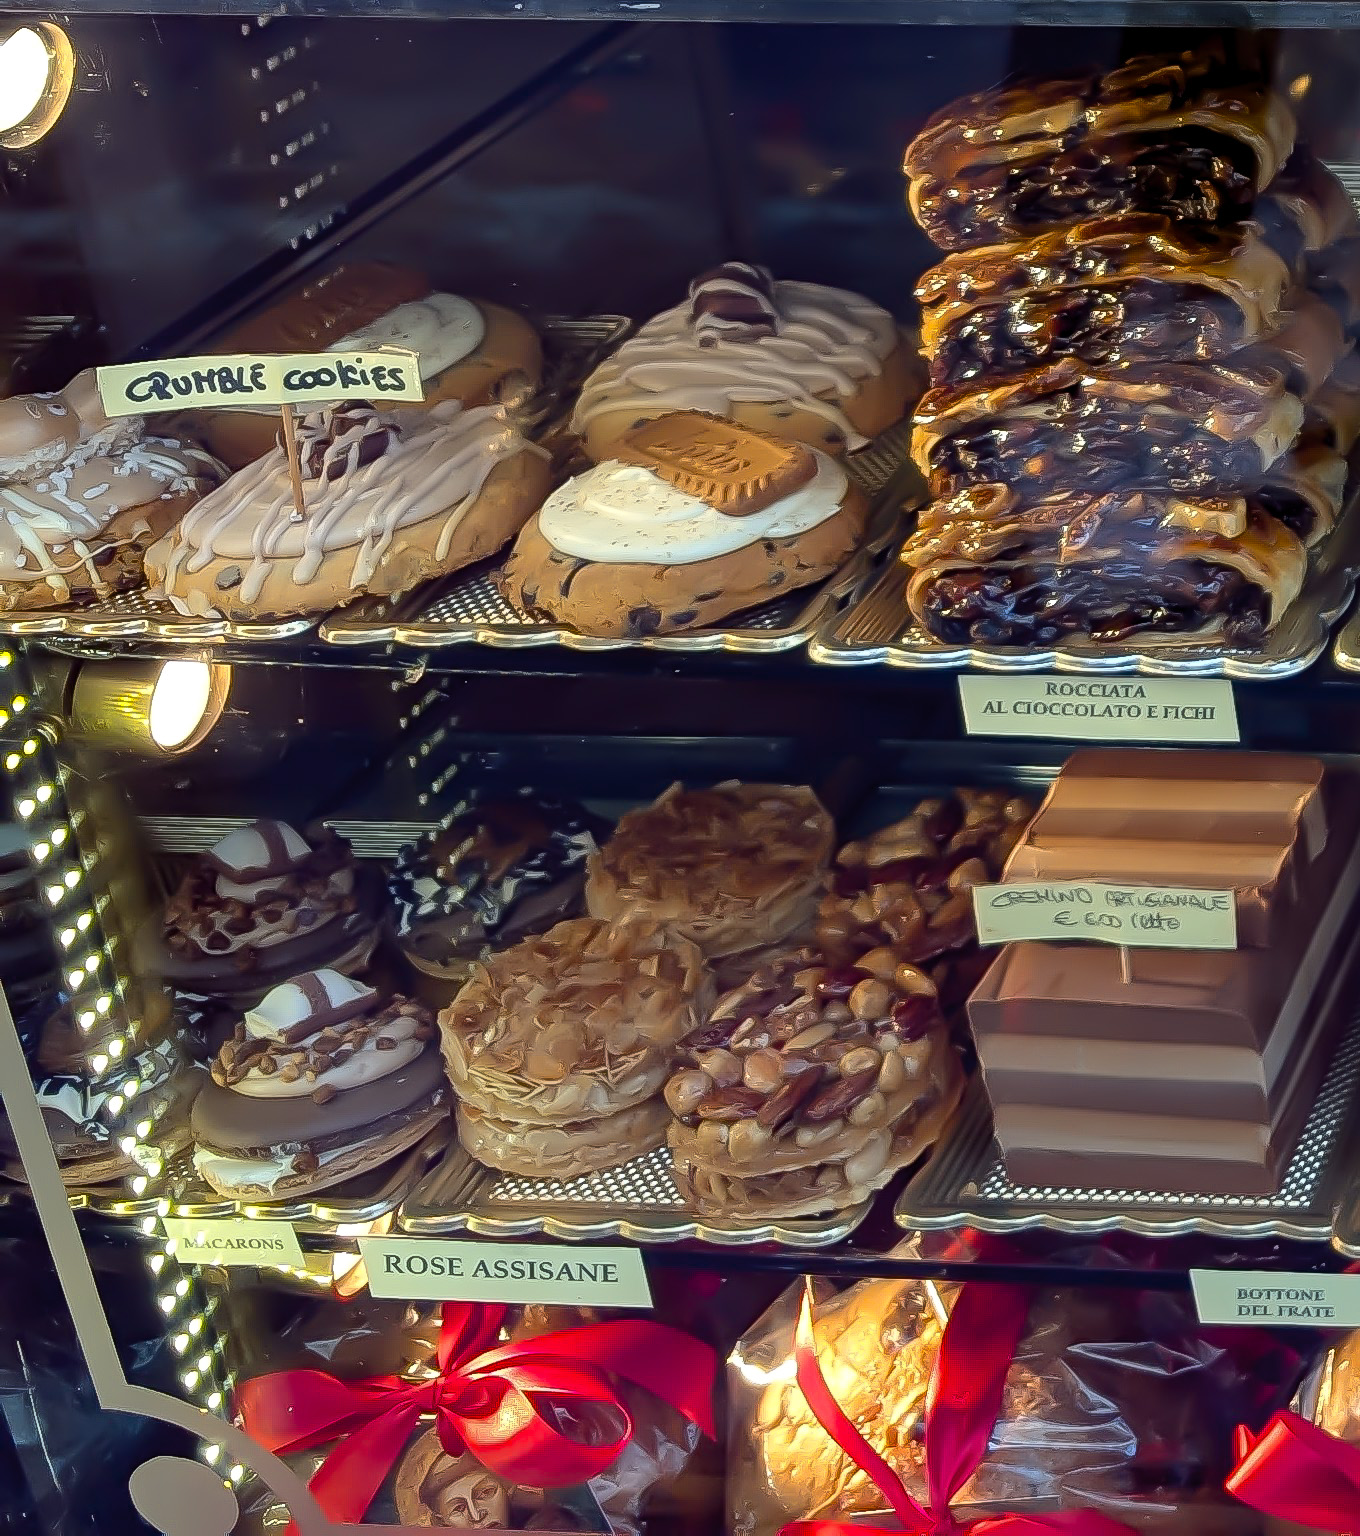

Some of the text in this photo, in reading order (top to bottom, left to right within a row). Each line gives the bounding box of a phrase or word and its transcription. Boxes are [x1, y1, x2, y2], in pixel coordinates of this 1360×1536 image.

[125, 362, 267, 403] CRUMBLE
[1045, 681, 1147, 699] ROCCIATA
[981, 700, 1216, 720] AL CIOCCOLATO E FICHI
[182, 1236, 285, 1252] MACARONS
[383, 1253, 620, 1284] ROSE ASSISANE
[1236, 1287, 1326, 1301] BOTTONE
[1237, 1304, 1336, 1318] DEL FRATE
